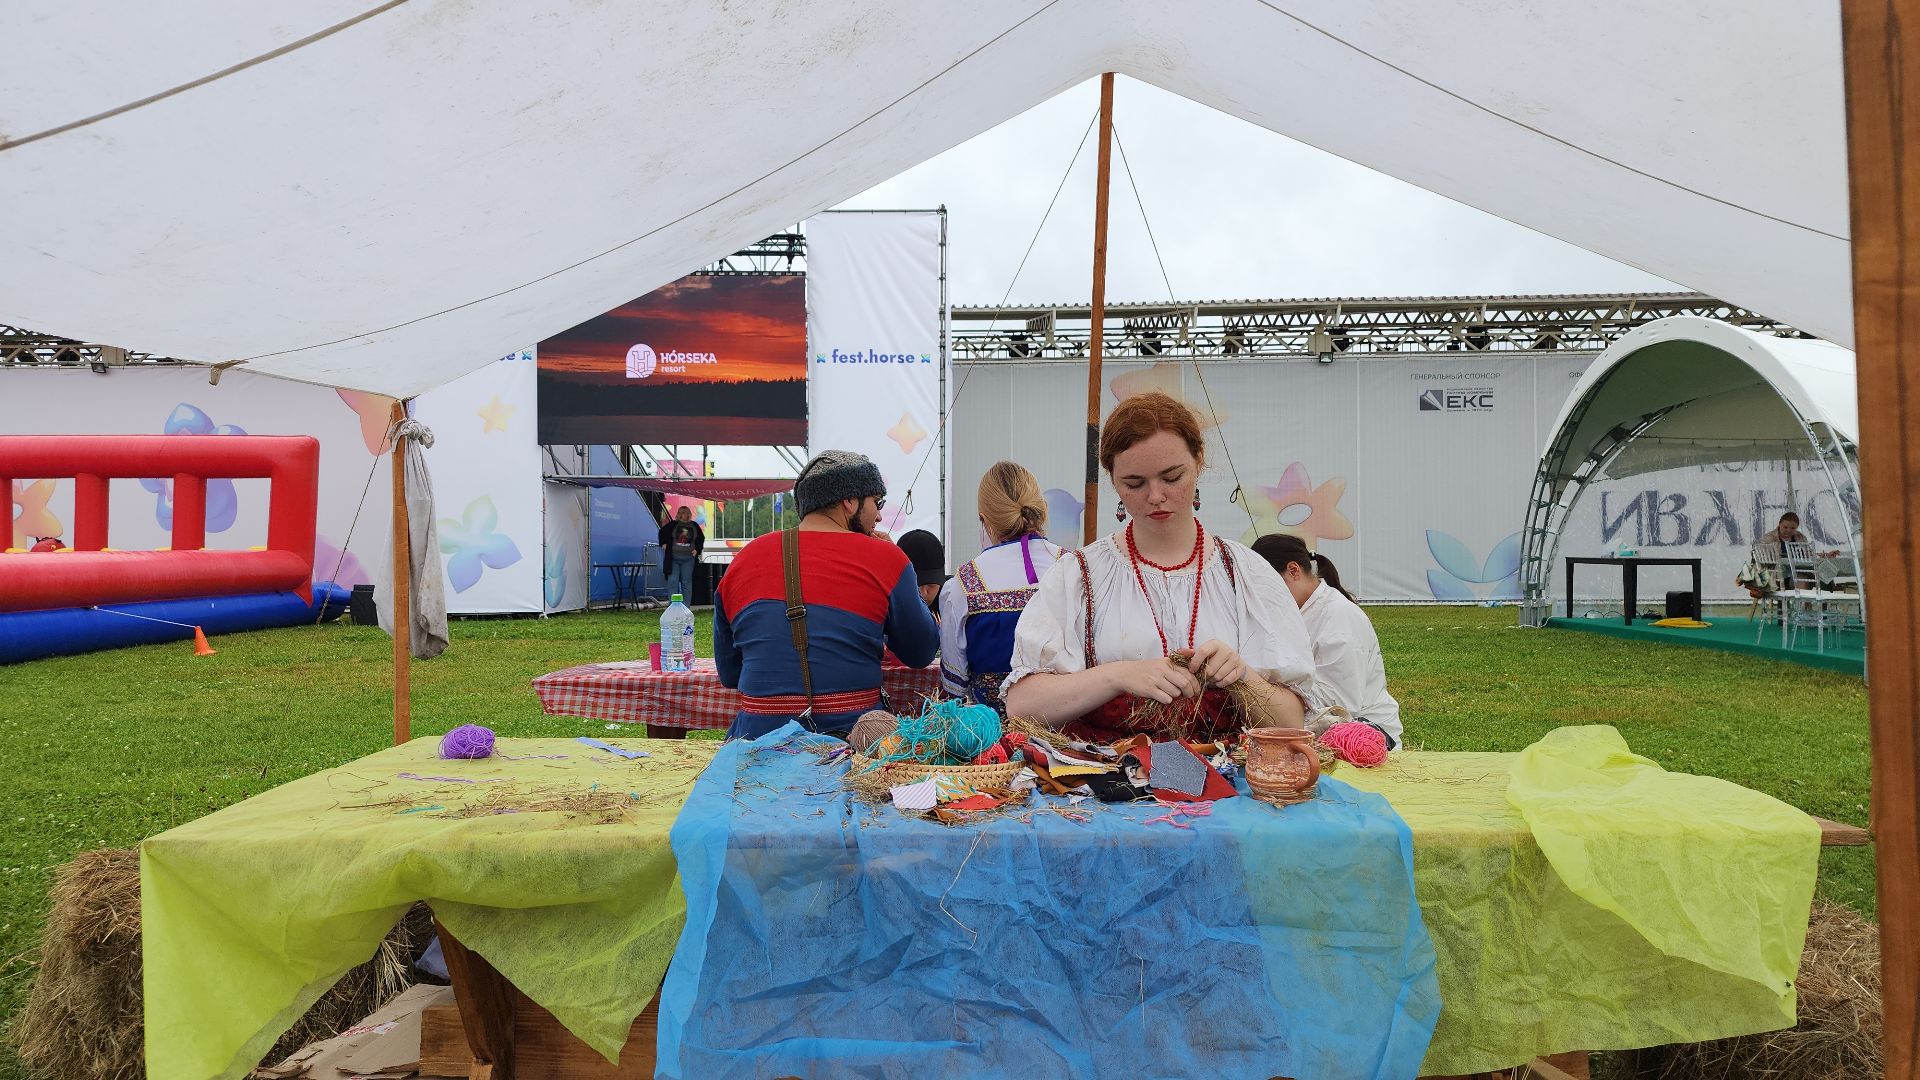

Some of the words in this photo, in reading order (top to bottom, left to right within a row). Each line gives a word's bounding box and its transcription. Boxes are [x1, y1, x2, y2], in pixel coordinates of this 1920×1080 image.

[660, 349, 717, 364] HÓRSEKA
[832, 348, 915, 364] fest.horse
[661, 365, 686, 373] resort
[1464, 372, 1501, 380] СПОНСОР
